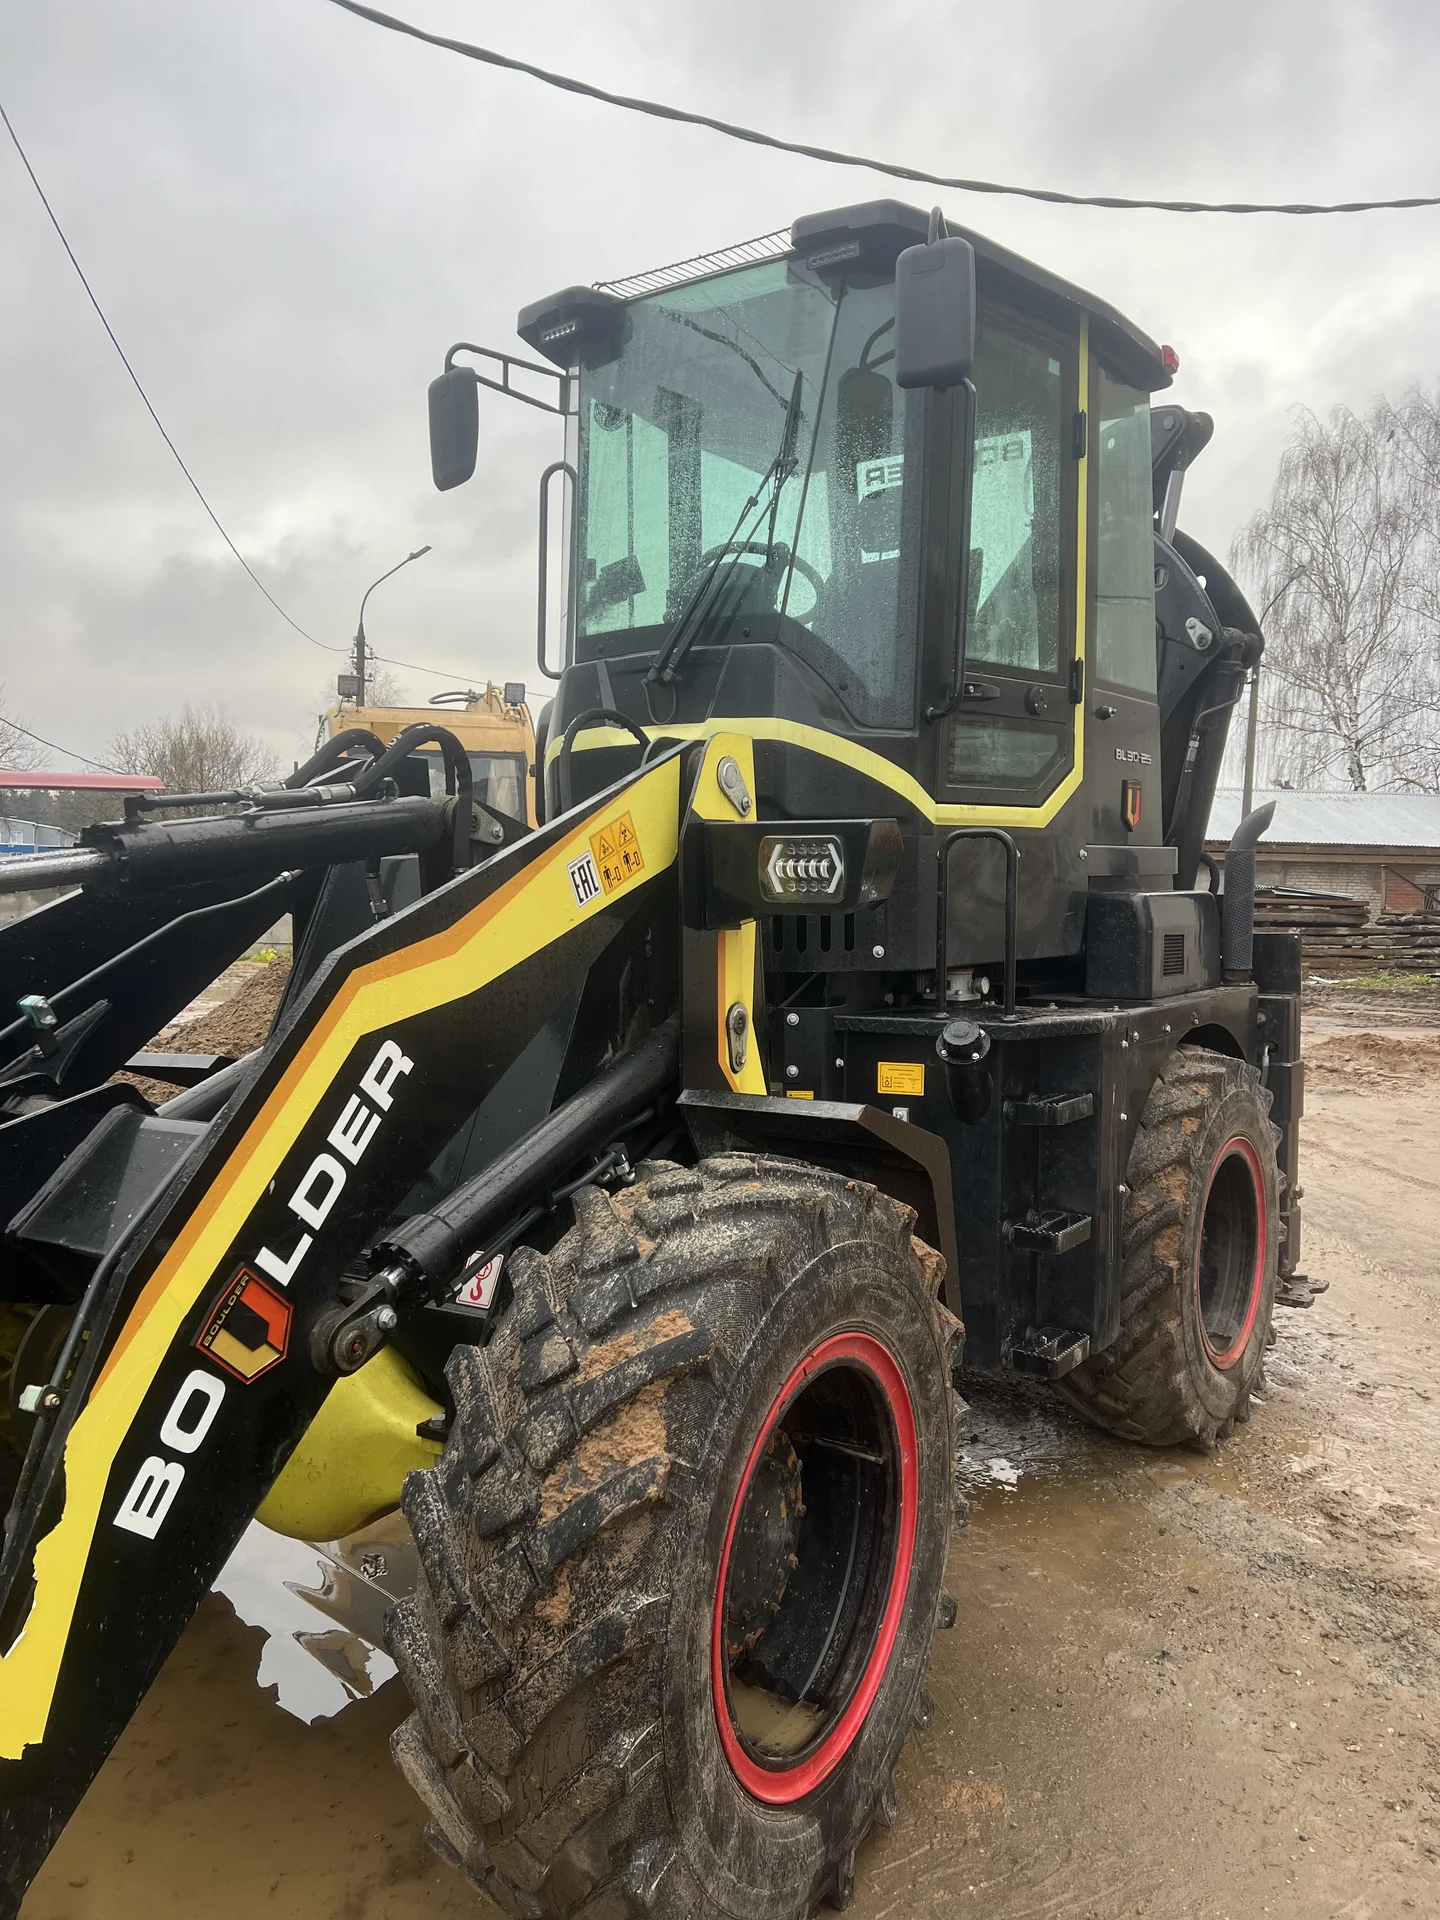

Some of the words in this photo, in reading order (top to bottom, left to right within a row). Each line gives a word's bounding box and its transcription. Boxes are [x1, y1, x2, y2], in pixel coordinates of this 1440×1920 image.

[1114, 748, 1152, 765] BL30-25
[570, 859, 600, 904] EAC
[202, 1274, 250, 1348] BOULDER
